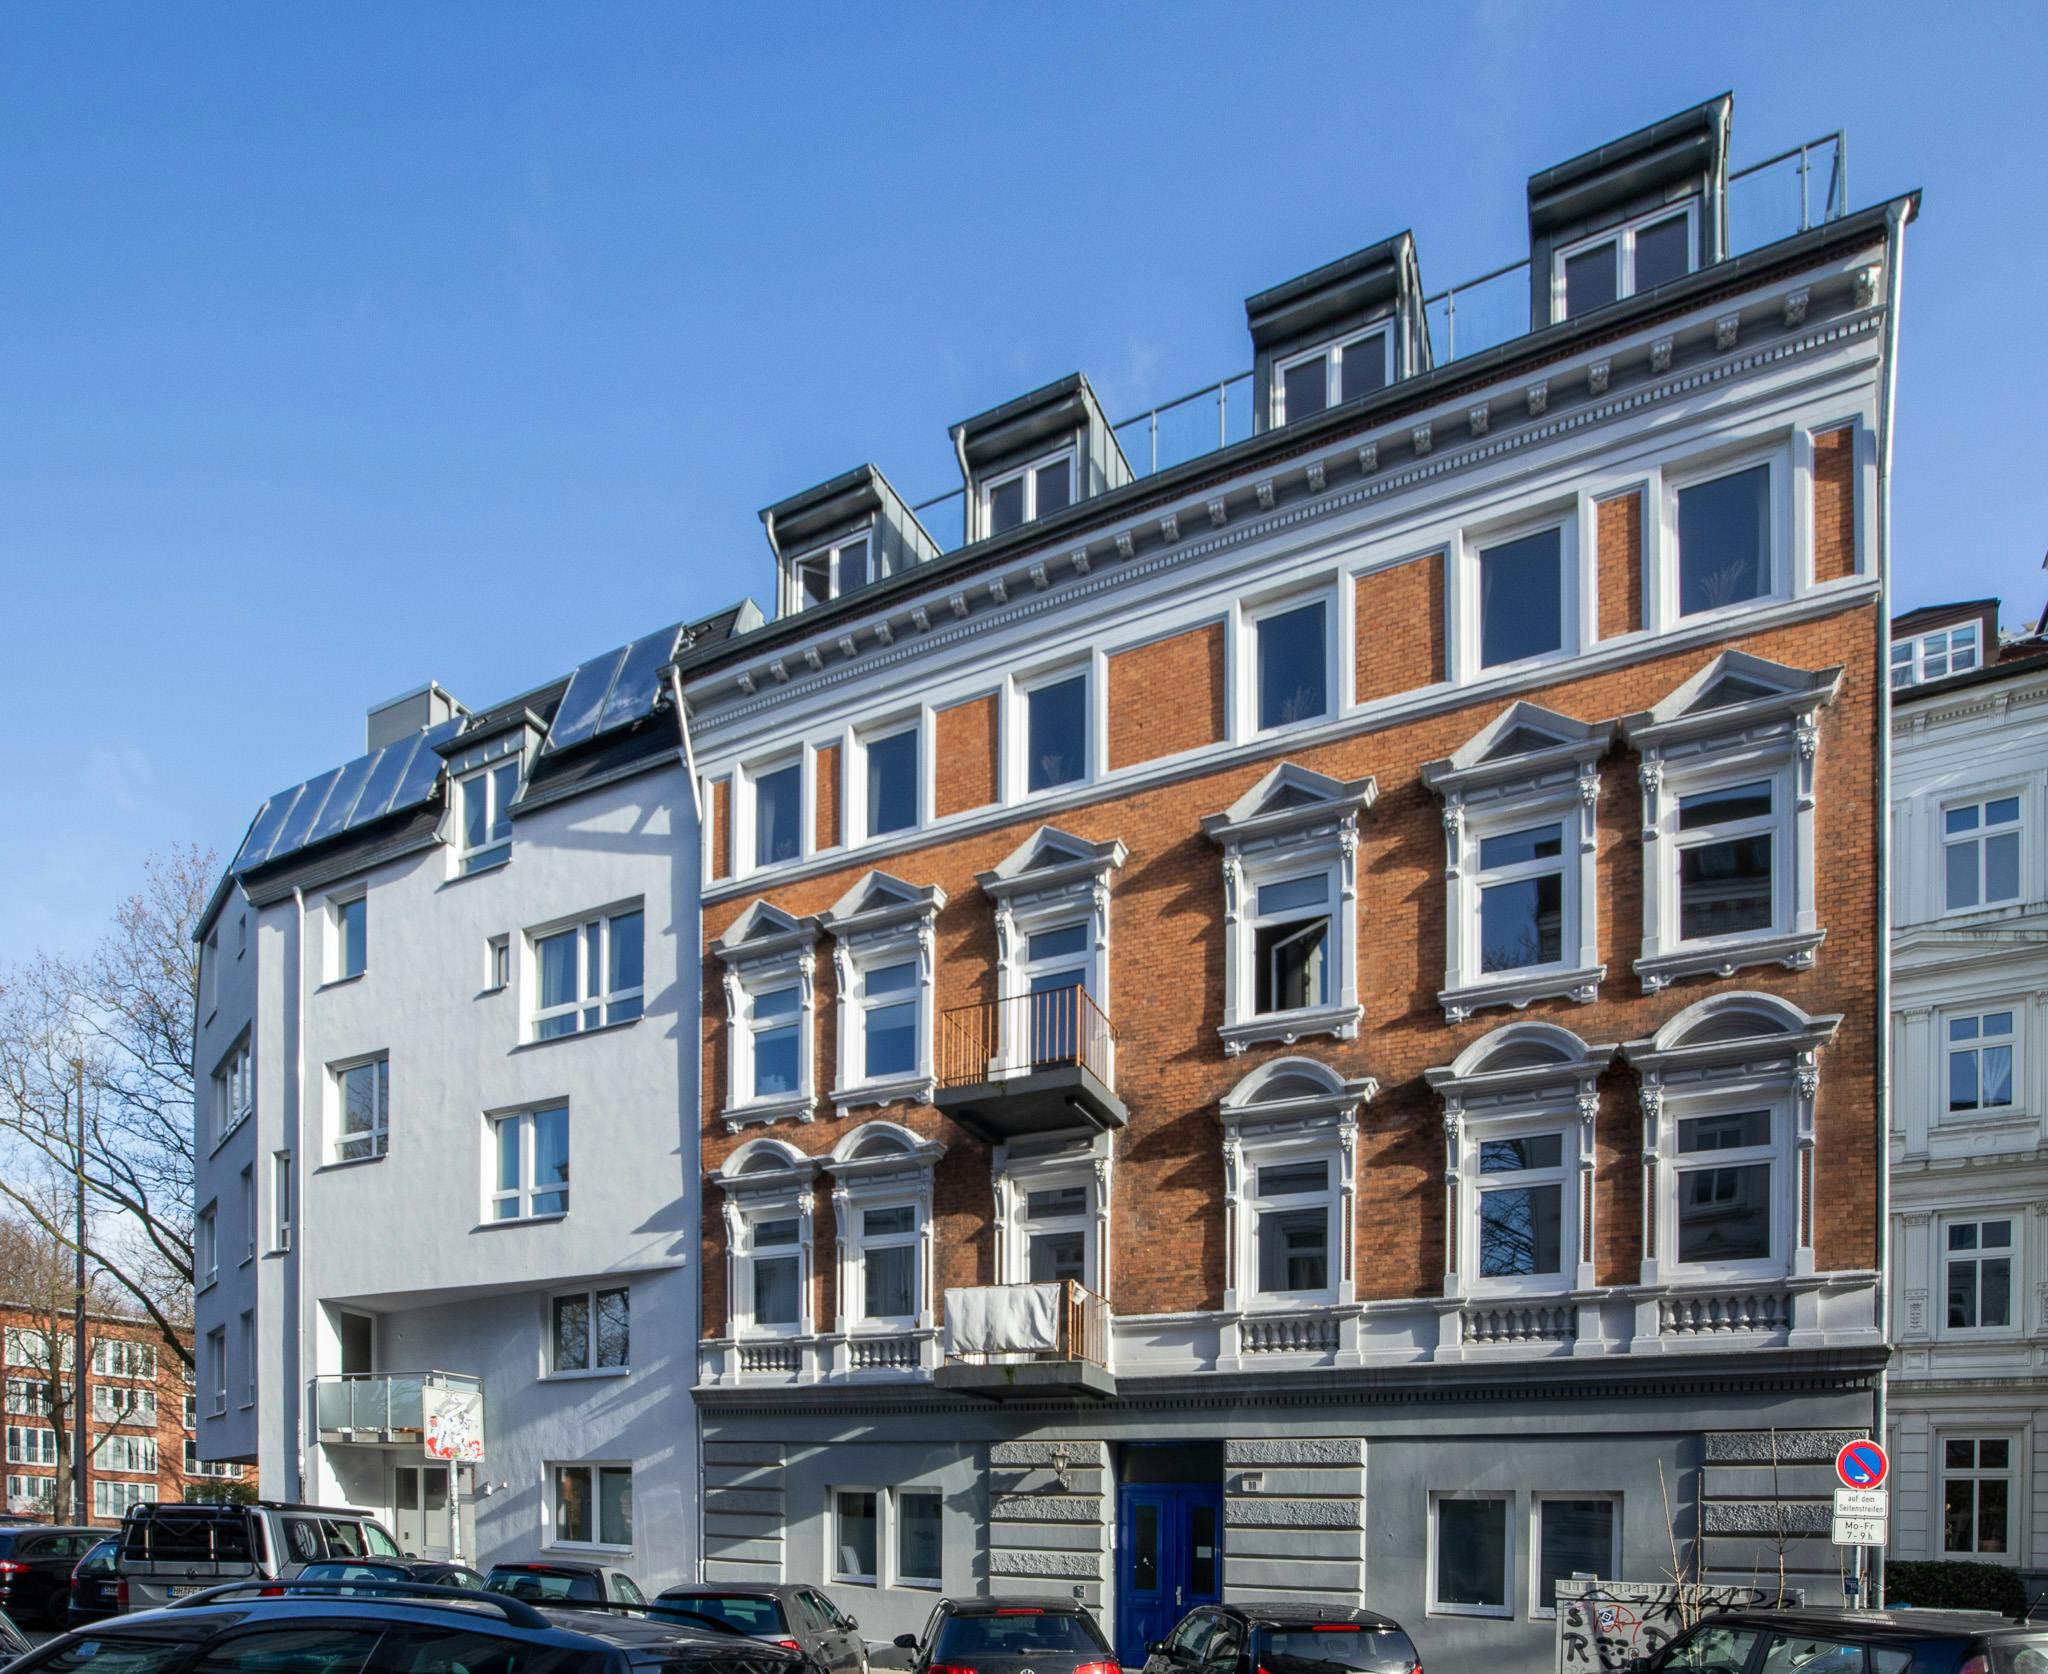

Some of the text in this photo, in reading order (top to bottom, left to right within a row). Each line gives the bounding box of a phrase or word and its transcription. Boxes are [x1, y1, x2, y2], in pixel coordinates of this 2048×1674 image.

[1848, 1495, 1858, 1503] auf
[1840, 1504, 1884, 1513] Seitenstreifen
[1845, 1521, 1874, 1530] Mo-Fr
